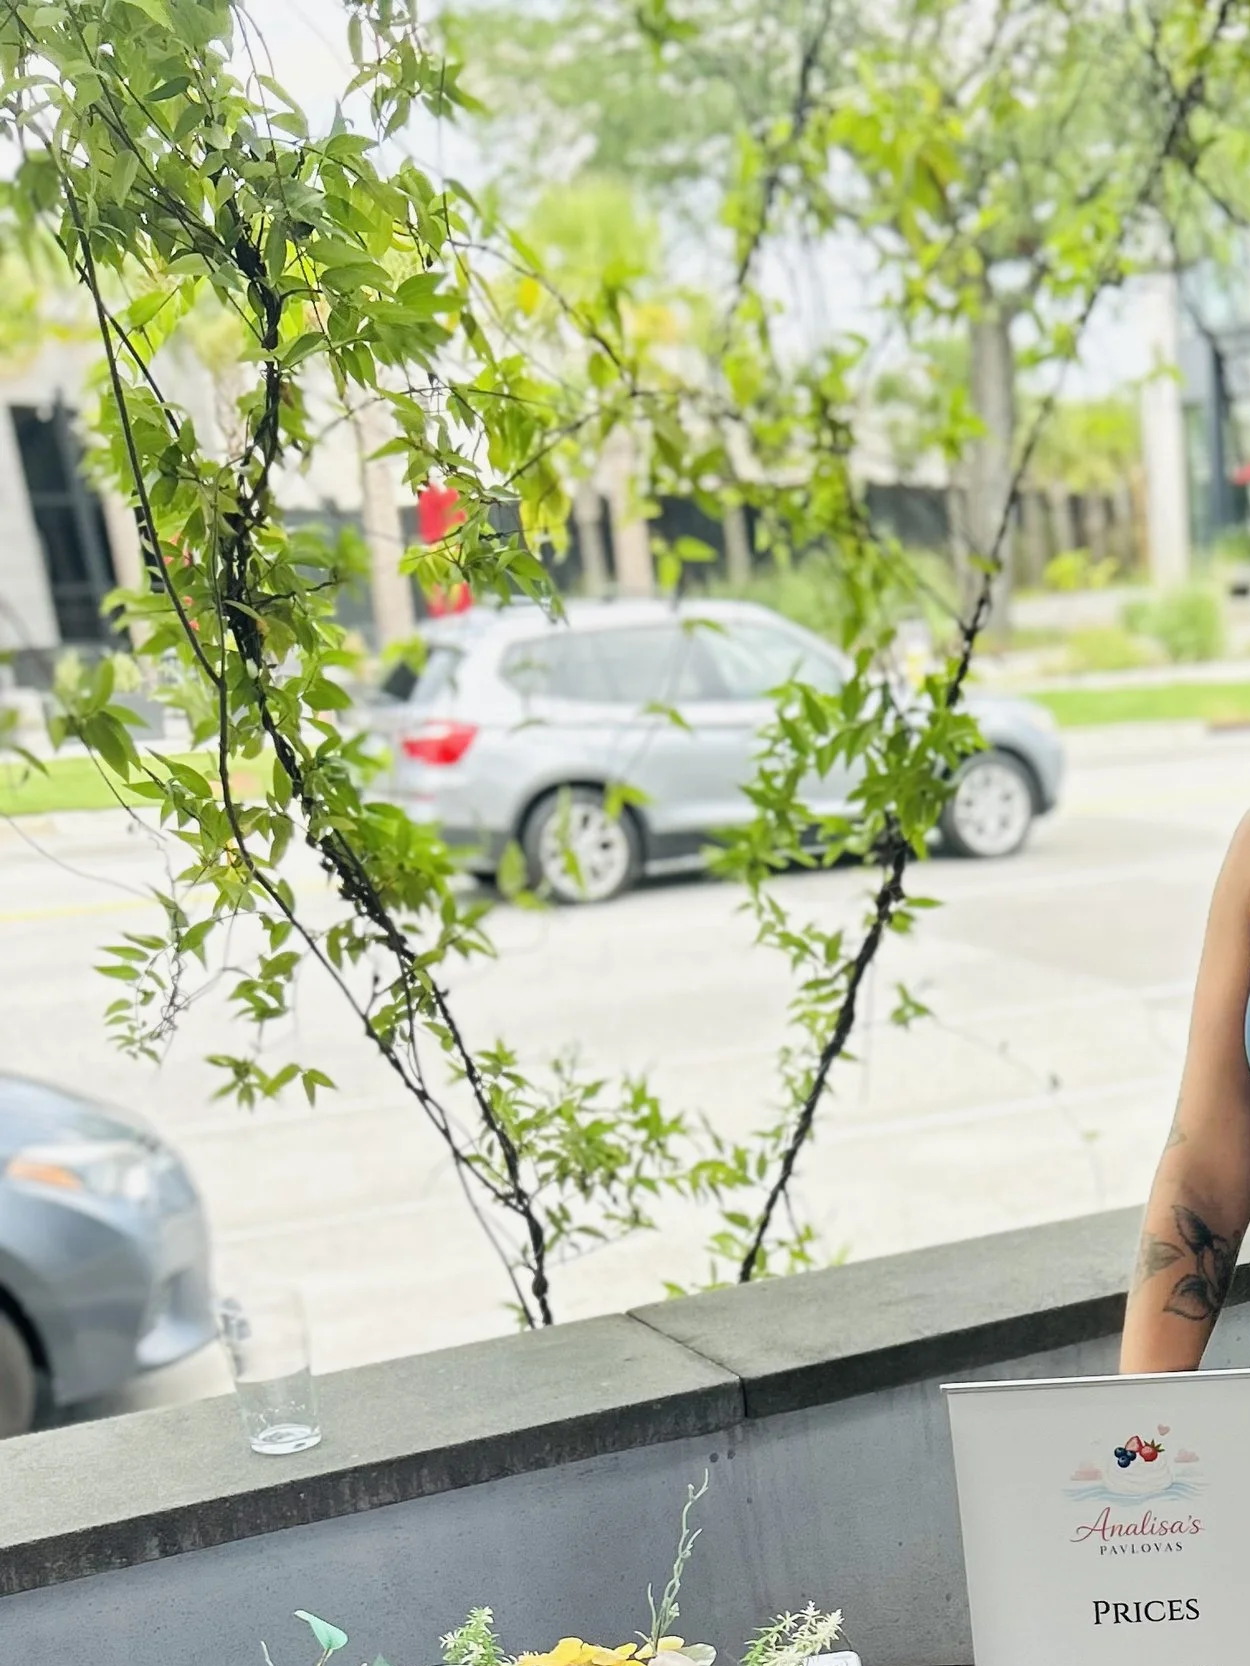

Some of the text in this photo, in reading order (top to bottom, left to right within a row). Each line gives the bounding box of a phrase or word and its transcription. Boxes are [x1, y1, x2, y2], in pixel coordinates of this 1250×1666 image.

[1070, 1506, 1204, 1544] Analisa's
[1099, 1540, 1184, 1556] PAVLOVAS
[1091, 1598, 1201, 1626] PRICES
